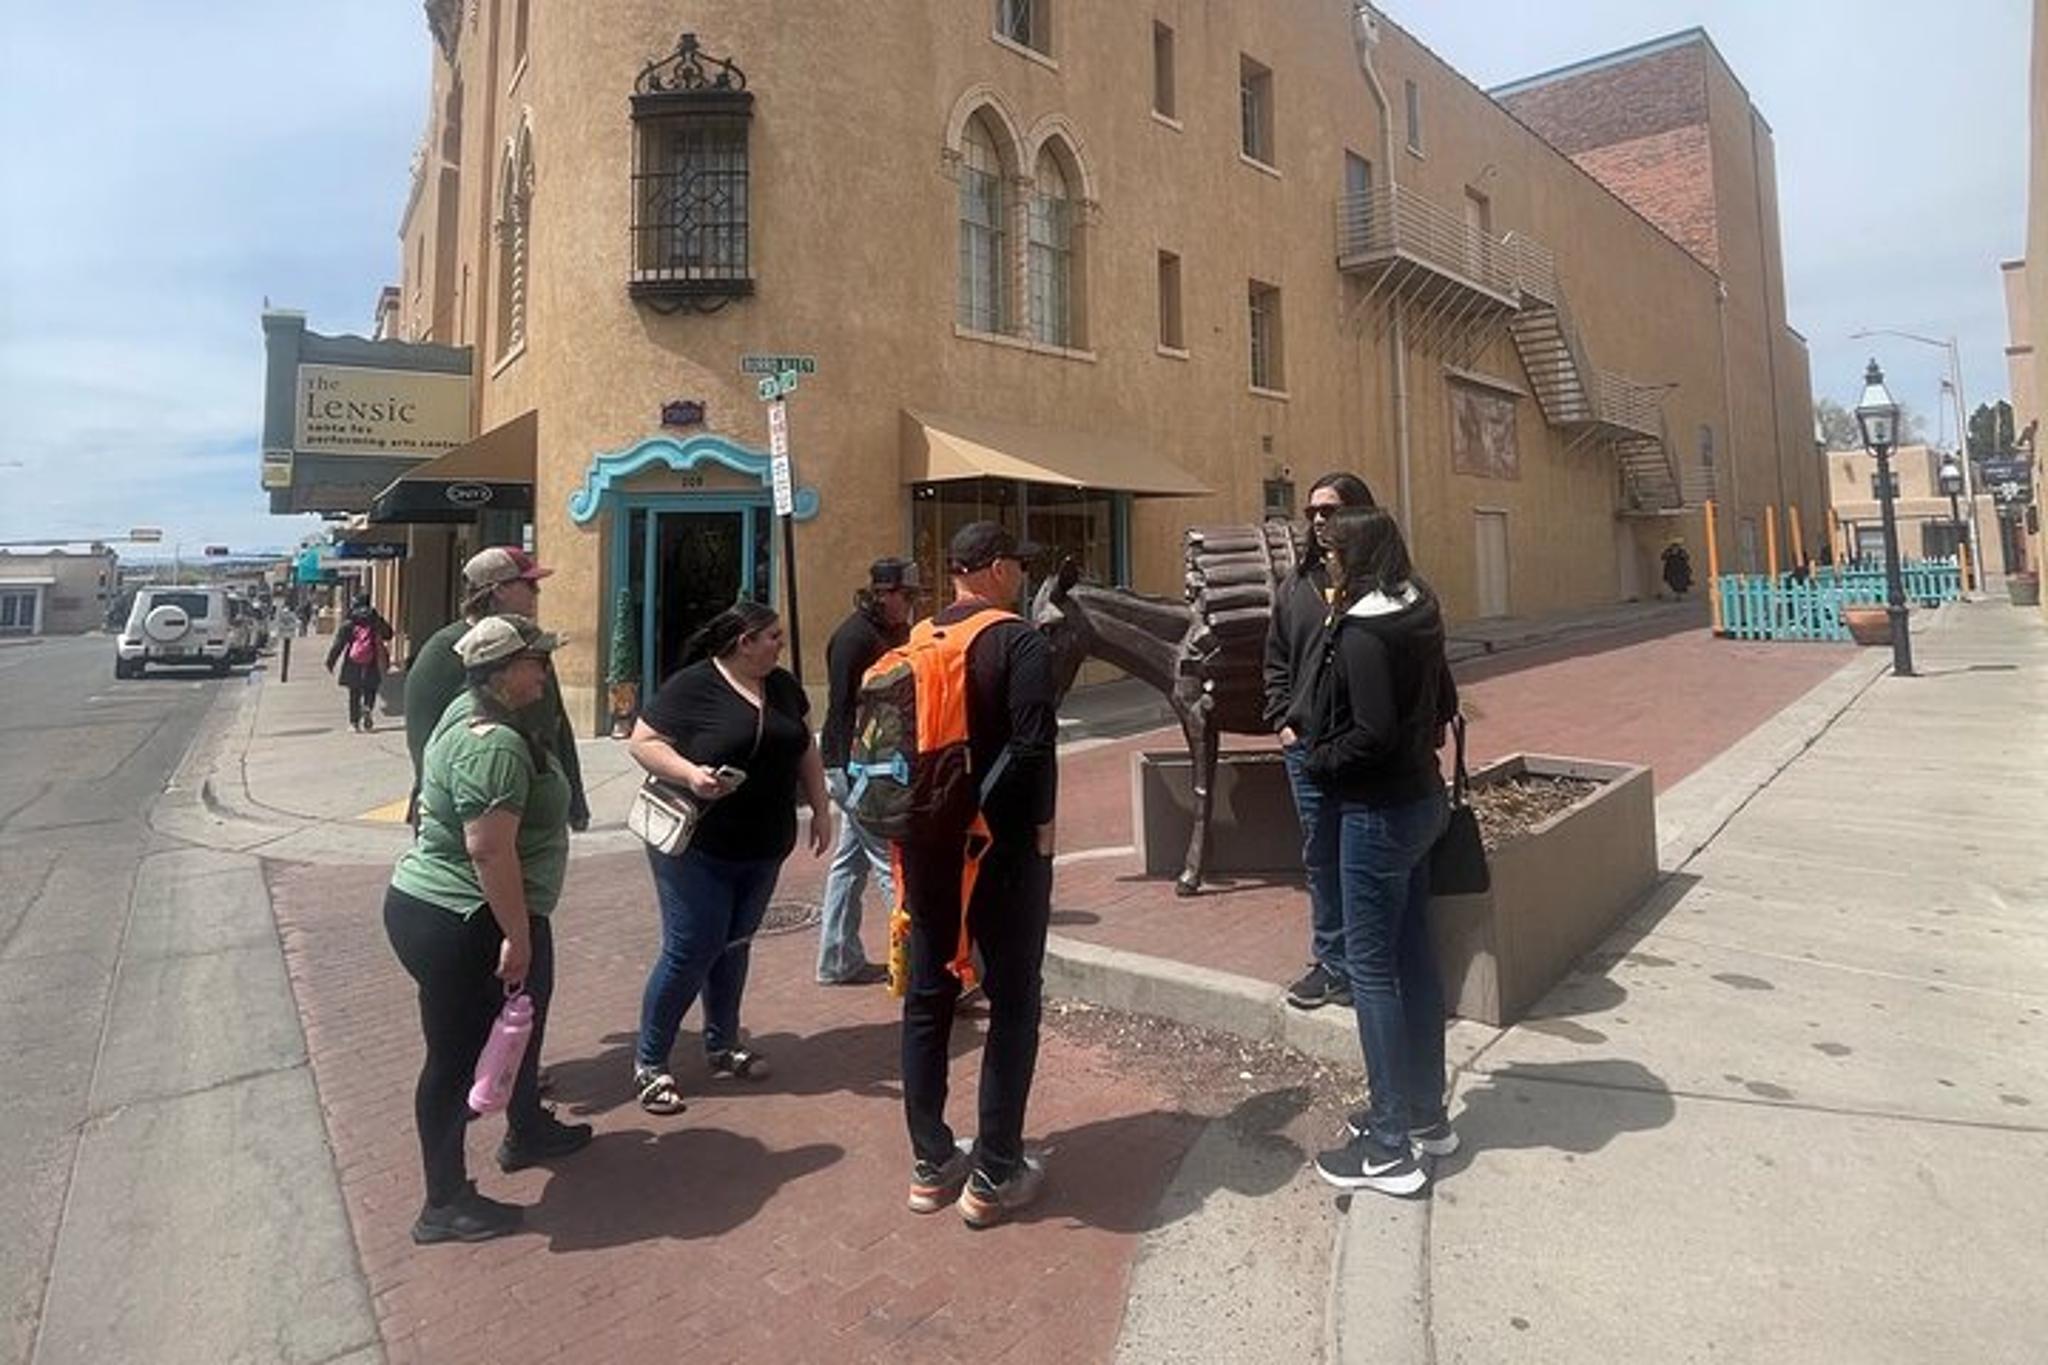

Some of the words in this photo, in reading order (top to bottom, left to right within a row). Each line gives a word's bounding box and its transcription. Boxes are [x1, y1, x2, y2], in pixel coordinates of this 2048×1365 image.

[307, 376, 341, 391] the
[307, 392, 417, 424] Lensic
[307, 435, 386, 449] performing
